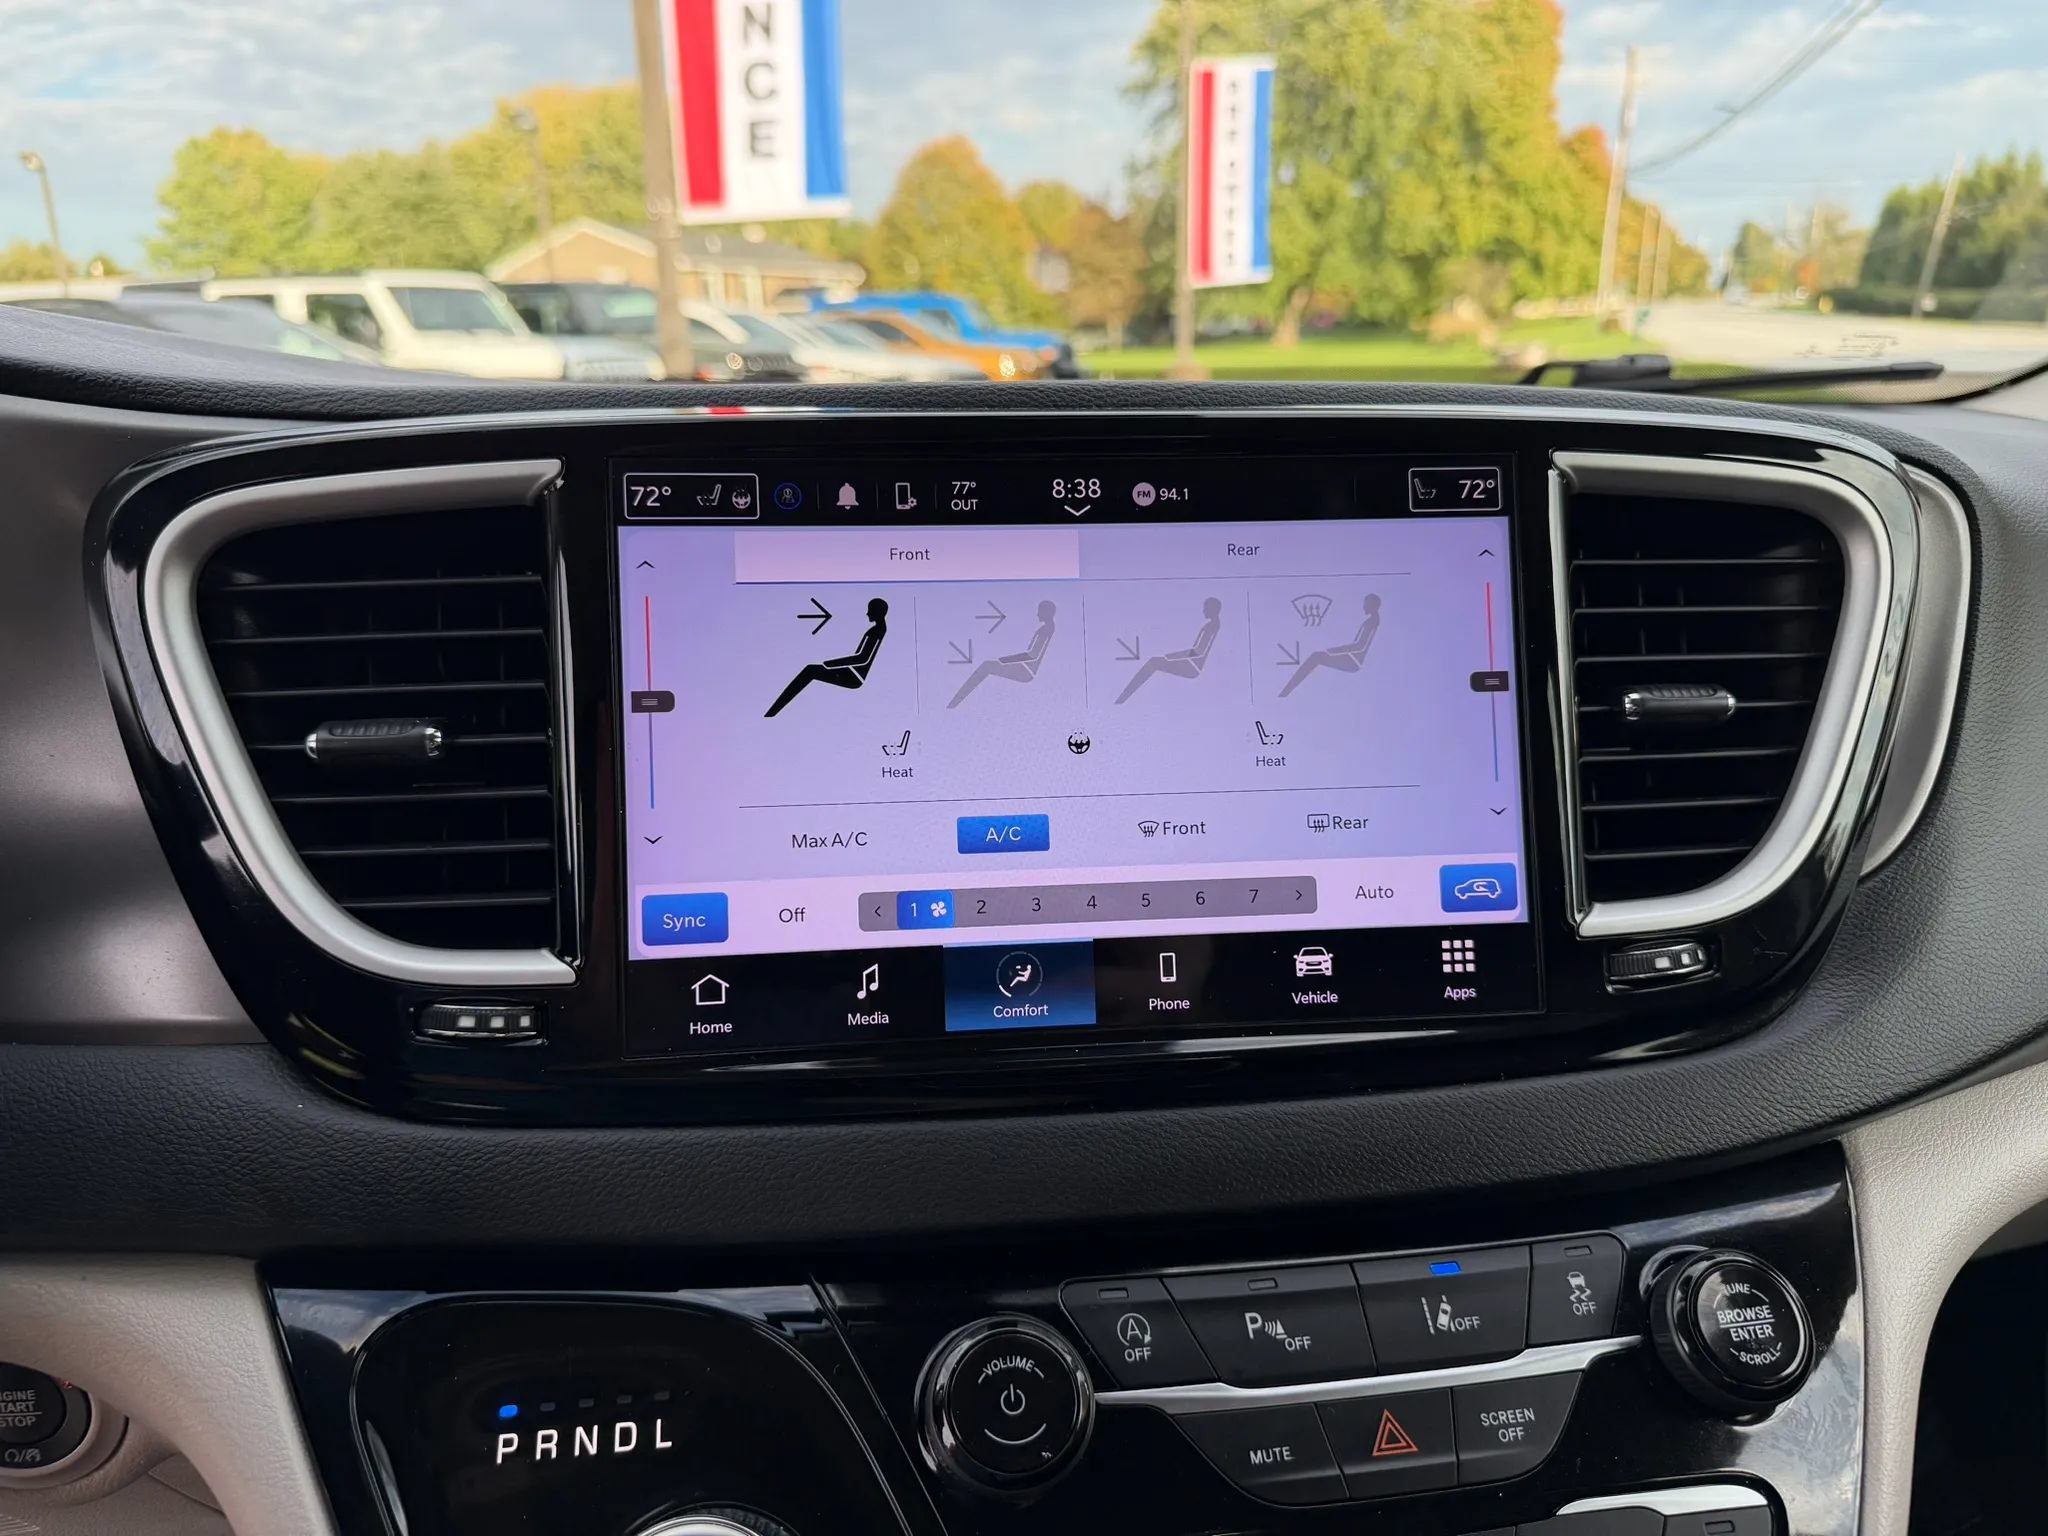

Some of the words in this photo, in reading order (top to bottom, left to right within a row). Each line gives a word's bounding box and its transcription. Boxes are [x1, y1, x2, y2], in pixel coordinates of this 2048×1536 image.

[951, 481, 977, 496] 77°
[1052, 478, 1101, 498] 8:38
[1137, 490, 1151, 499] FM
[1159, 488, 1189, 501] 94.1
[1459, 480, 1496, 499] 72°
[630, 486, 672, 507] 72°
[951, 499, 978, 511] OUT
[889, 547, 931, 561] Front
[1227, 543, 1260, 557] Rear
[1256, 755, 1286, 768] Heat
[881, 765, 913, 779] Heat
[1162, 820, 1206, 836] Front
[1332, 815, 1369, 830] Rear
[791, 833, 828, 849] Max
[831, 831, 868, 848] A/C
[985, 826, 1022, 843] A/C
[1355, 883, 1394, 900] Auto
[910, 902, 918, 918] 1
[976, 899, 987, 915] 2
[1031, 897, 1041, 913] 3
[1086, 894, 1097, 909] 4
[1141, 893, 1151, 908] 5
[1195, 890, 1206, 906] 6
[1248, 888, 1259, 904] 7
[662, 911, 707, 932] Sync
[778, 907, 806, 924] Off
[1291, 990, 1339, 1006] Vehicle
[1444, 985, 1477, 1001] Apps
[993, 1003, 1049, 1019] Comfort
[1148, 997, 1190, 1012] Phone
[847, 1011, 890, 1027] Media
[689, 1020, 733, 1035] Home
[1572, 1301, 1597, 1316] OFF
[1716, 1305, 1774, 1324] BROWSE
[1454, 1315, 1481, 1331] OFF
[1729, 1324, 1775, 1342] ENTER
[1284, 1335, 1312, 1352] OFF
[1124, 1347, 1152, 1362] OFF
[1739, 1344, 1781, 1366] SCROLL
[982, 1356, 1035, 1377] VOLUME
[0, 1390, 36, 1401] GINE
[1480, 1408, 1536, 1427] SCREEN
[1498, 1426, 1525, 1443] OFF
[1249, 1445, 1292, 1466] MUTE
